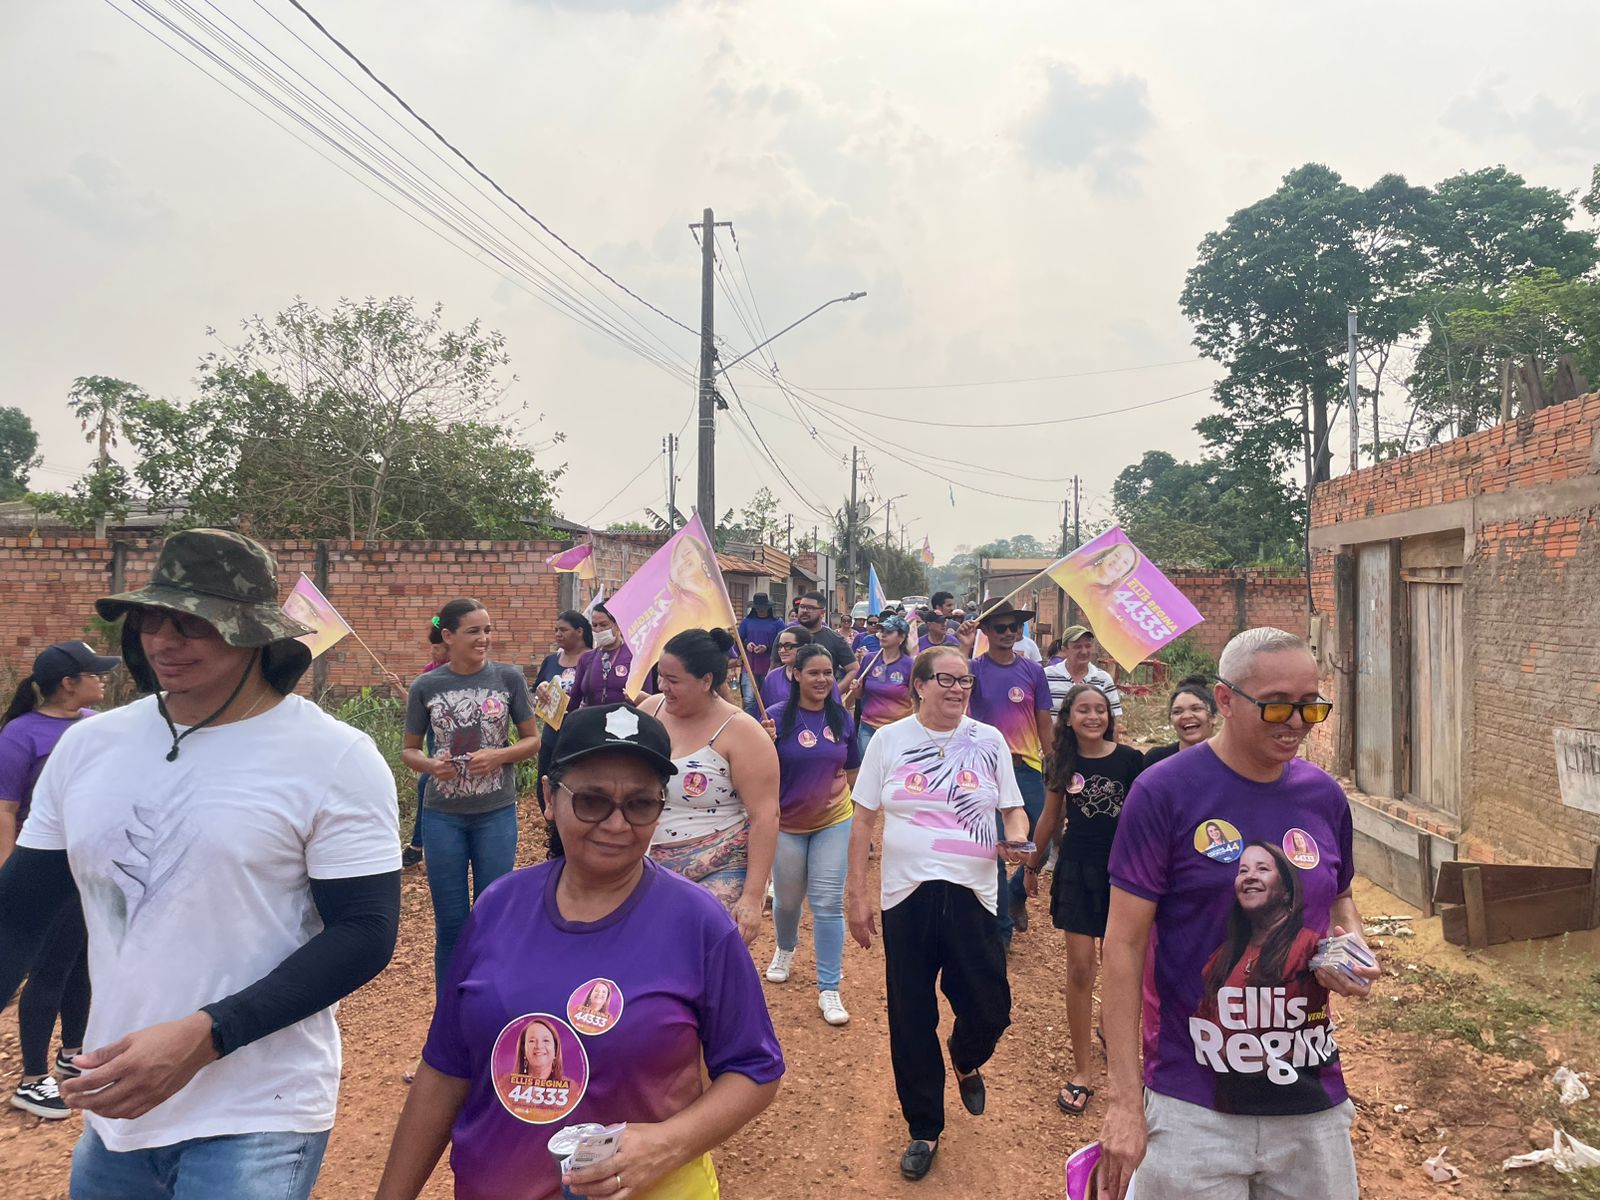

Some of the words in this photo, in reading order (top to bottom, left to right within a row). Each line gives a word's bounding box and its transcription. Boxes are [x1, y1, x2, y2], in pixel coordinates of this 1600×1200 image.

[1113, 590, 1173, 641] 44333
[1126, 580, 1151, 602] ELLIS
[1146, 600, 1178, 633] REGINA
[1226, 842, 1240, 852] 44
[574, 1011, 608, 1028] 44333
[1217, 986, 1308, 1030] Ellis
[1188, 1016, 1338, 1085] Regina
[508, 1085, 569, 1106] 44333
[510, 1076, 533, 1086] ELLIS
[534, 1078, 569, 1088] REGINA
